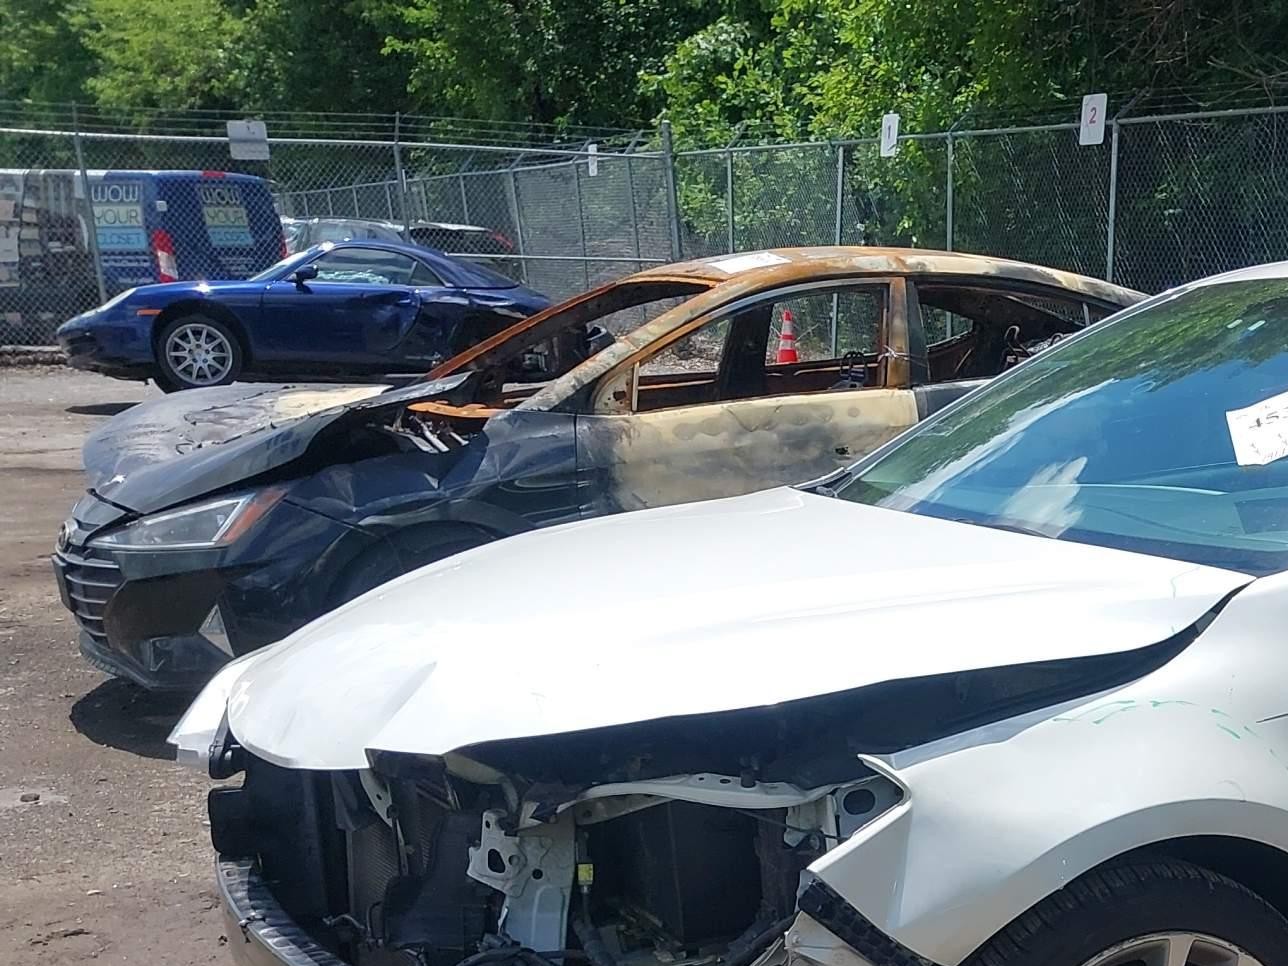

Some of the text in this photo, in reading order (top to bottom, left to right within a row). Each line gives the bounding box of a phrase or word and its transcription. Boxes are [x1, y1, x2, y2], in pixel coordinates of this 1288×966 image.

[1088, 106, 1097, 125] 2
[91, 184, 138, 202] WOW
[95, 208, 140, 225] YOUR
